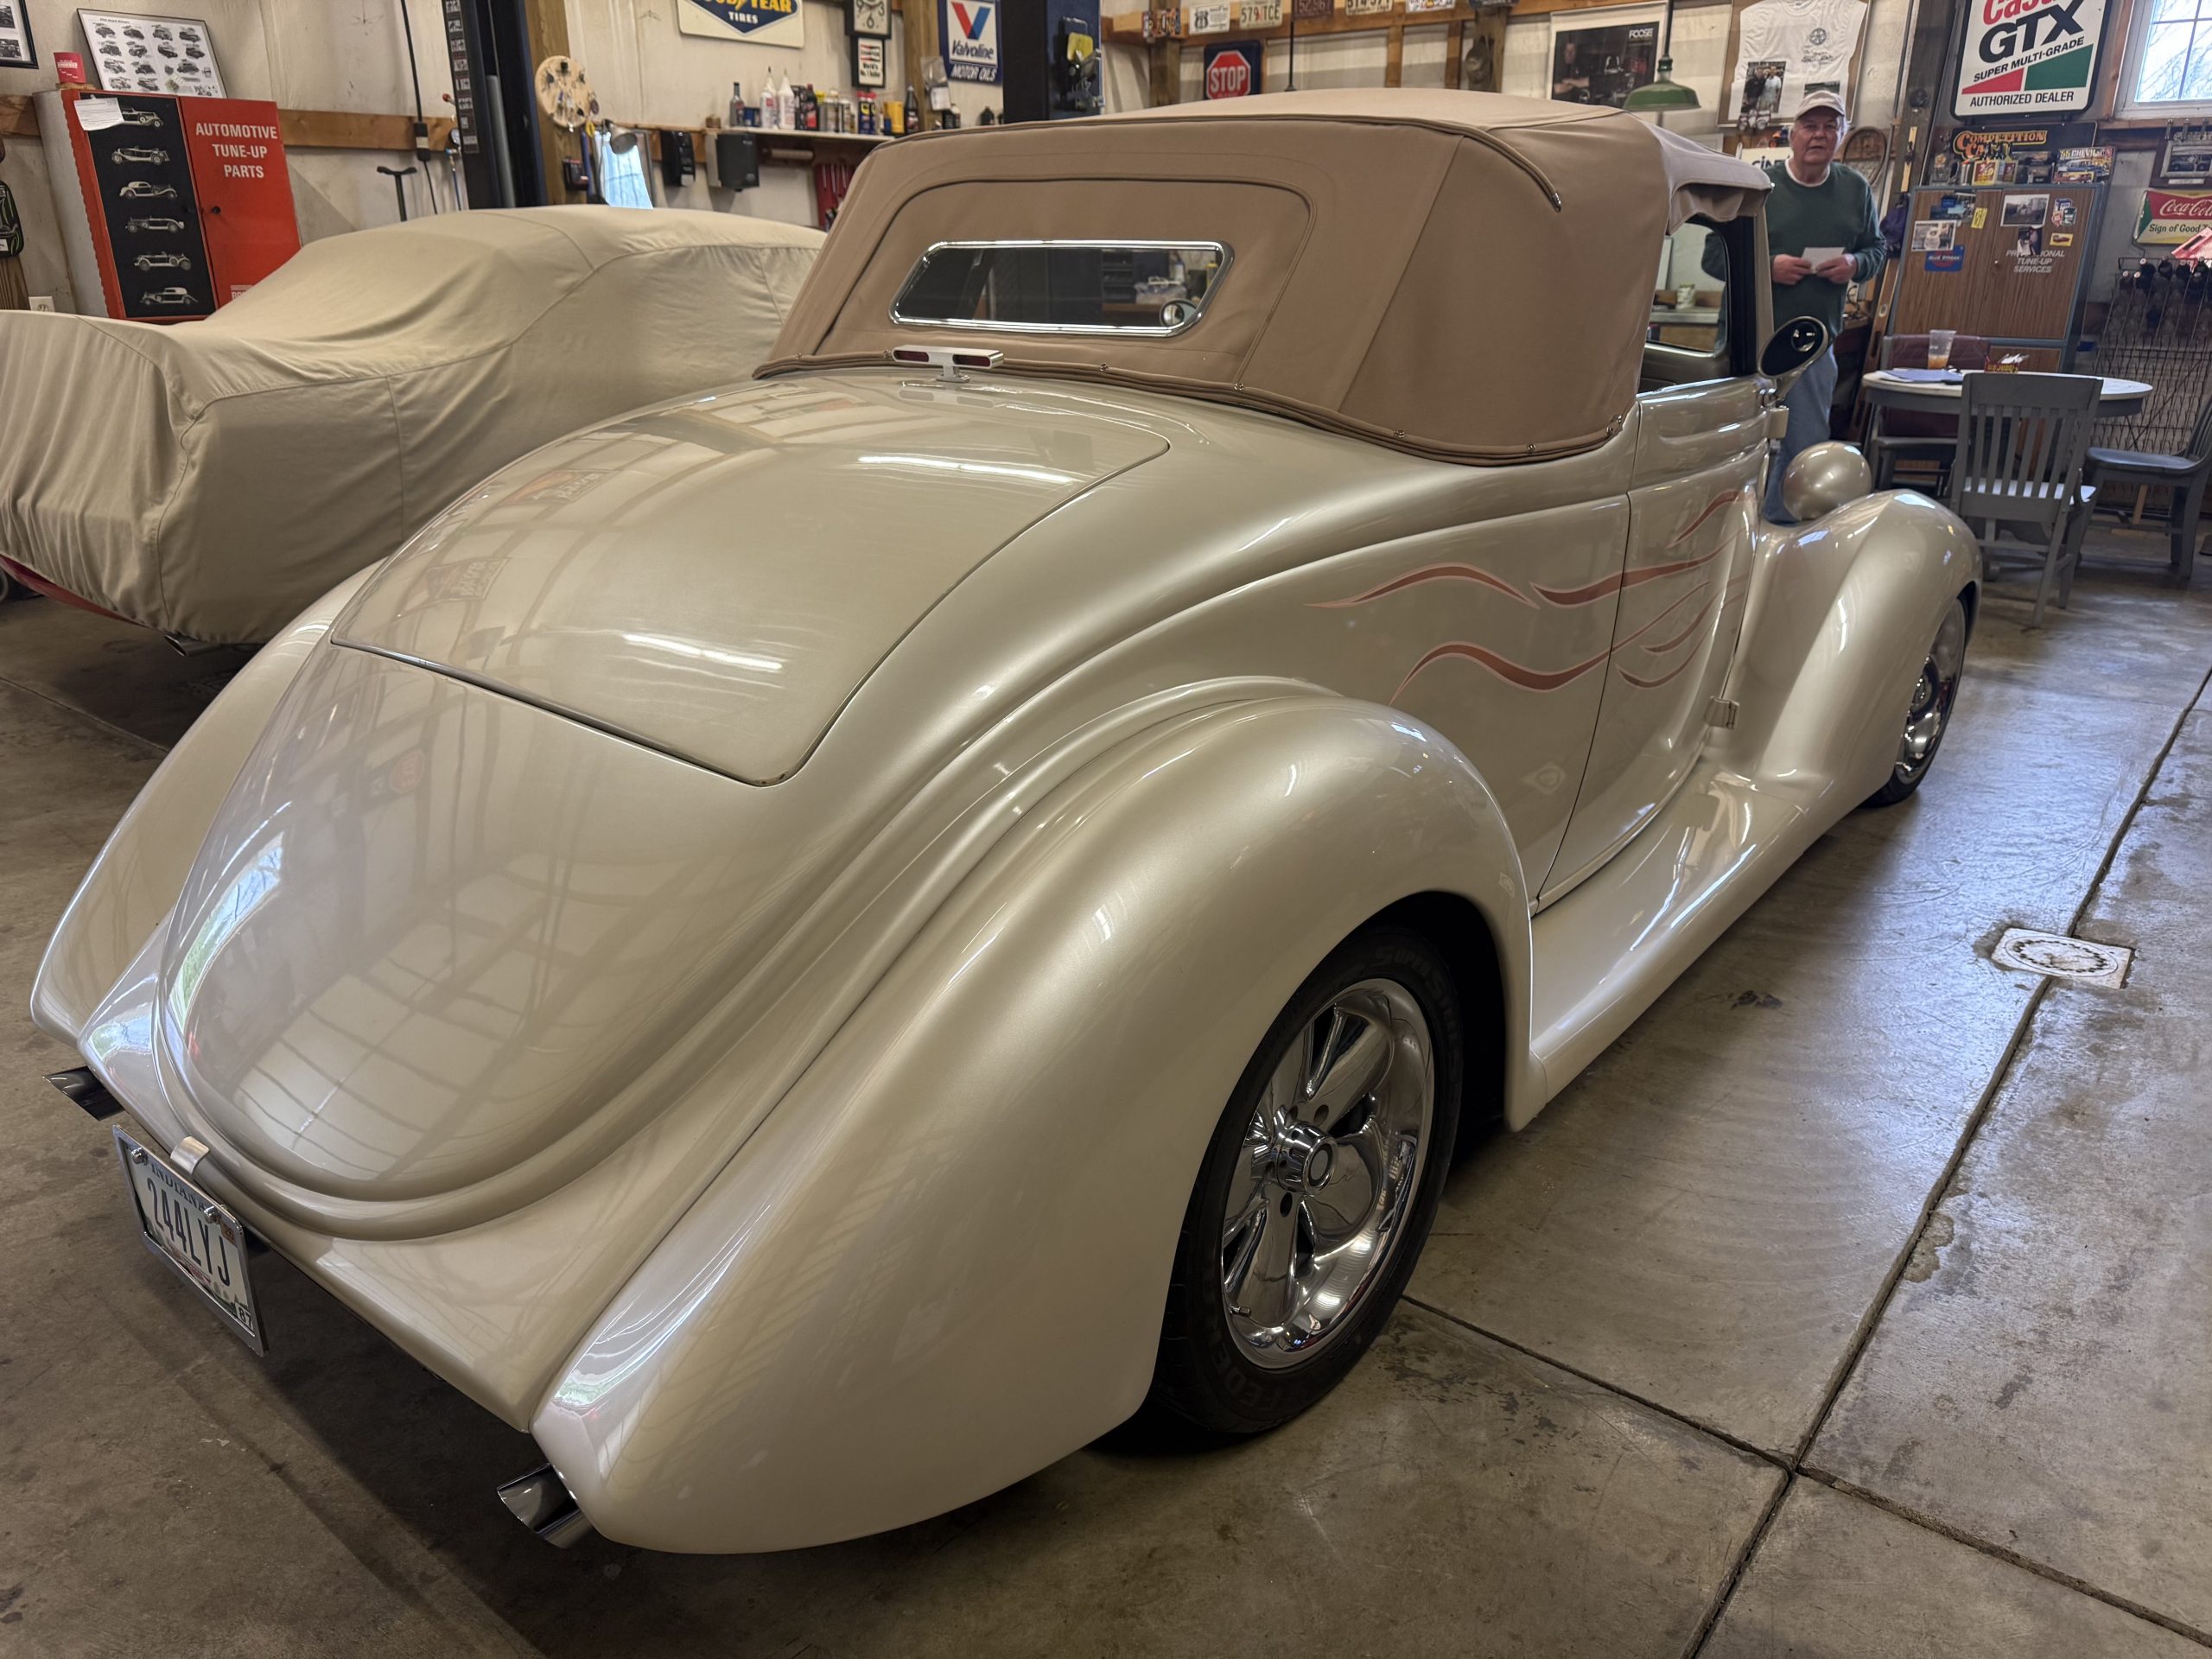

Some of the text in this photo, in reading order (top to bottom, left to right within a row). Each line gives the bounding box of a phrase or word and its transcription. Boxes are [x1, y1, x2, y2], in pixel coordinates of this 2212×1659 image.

[728, 11, 759, 24] TIRES
[867, 12, 874, 29] 6
[1241, 6, 1260, 23] 579
[1262, 3, 1281, 21] TCE
[1629, 28, 1654, 39] FOOSE
[1979, 0, 2084, 63] GTX
[952, 40, 994, 59] Valvoline
[1974, 36, 2084, 83] SUPER MULTI-GRADE
[951, 64, 998, 82] MOTOR OILS
[1211, 65, 1247, 93] STOP
[1970, 91, 2074, 107] AUTHORIZED DEALER
[195, 123, 278, 139] AUTOMOTIVE
[1956, 131, 2044, 150] COMPETITION
[211, 143, 268, 158] TUNE-UP
[224, 164, 264, 178] PARTS
[2149, 223, 2167, 234] Sign
[2169, 223, 2179, 232] of
[2179, 224, 2201, 233] Good
[150, 1163, 207, 1211] INDIANA
[147, 1177, 231, 1287] 244LYJ
